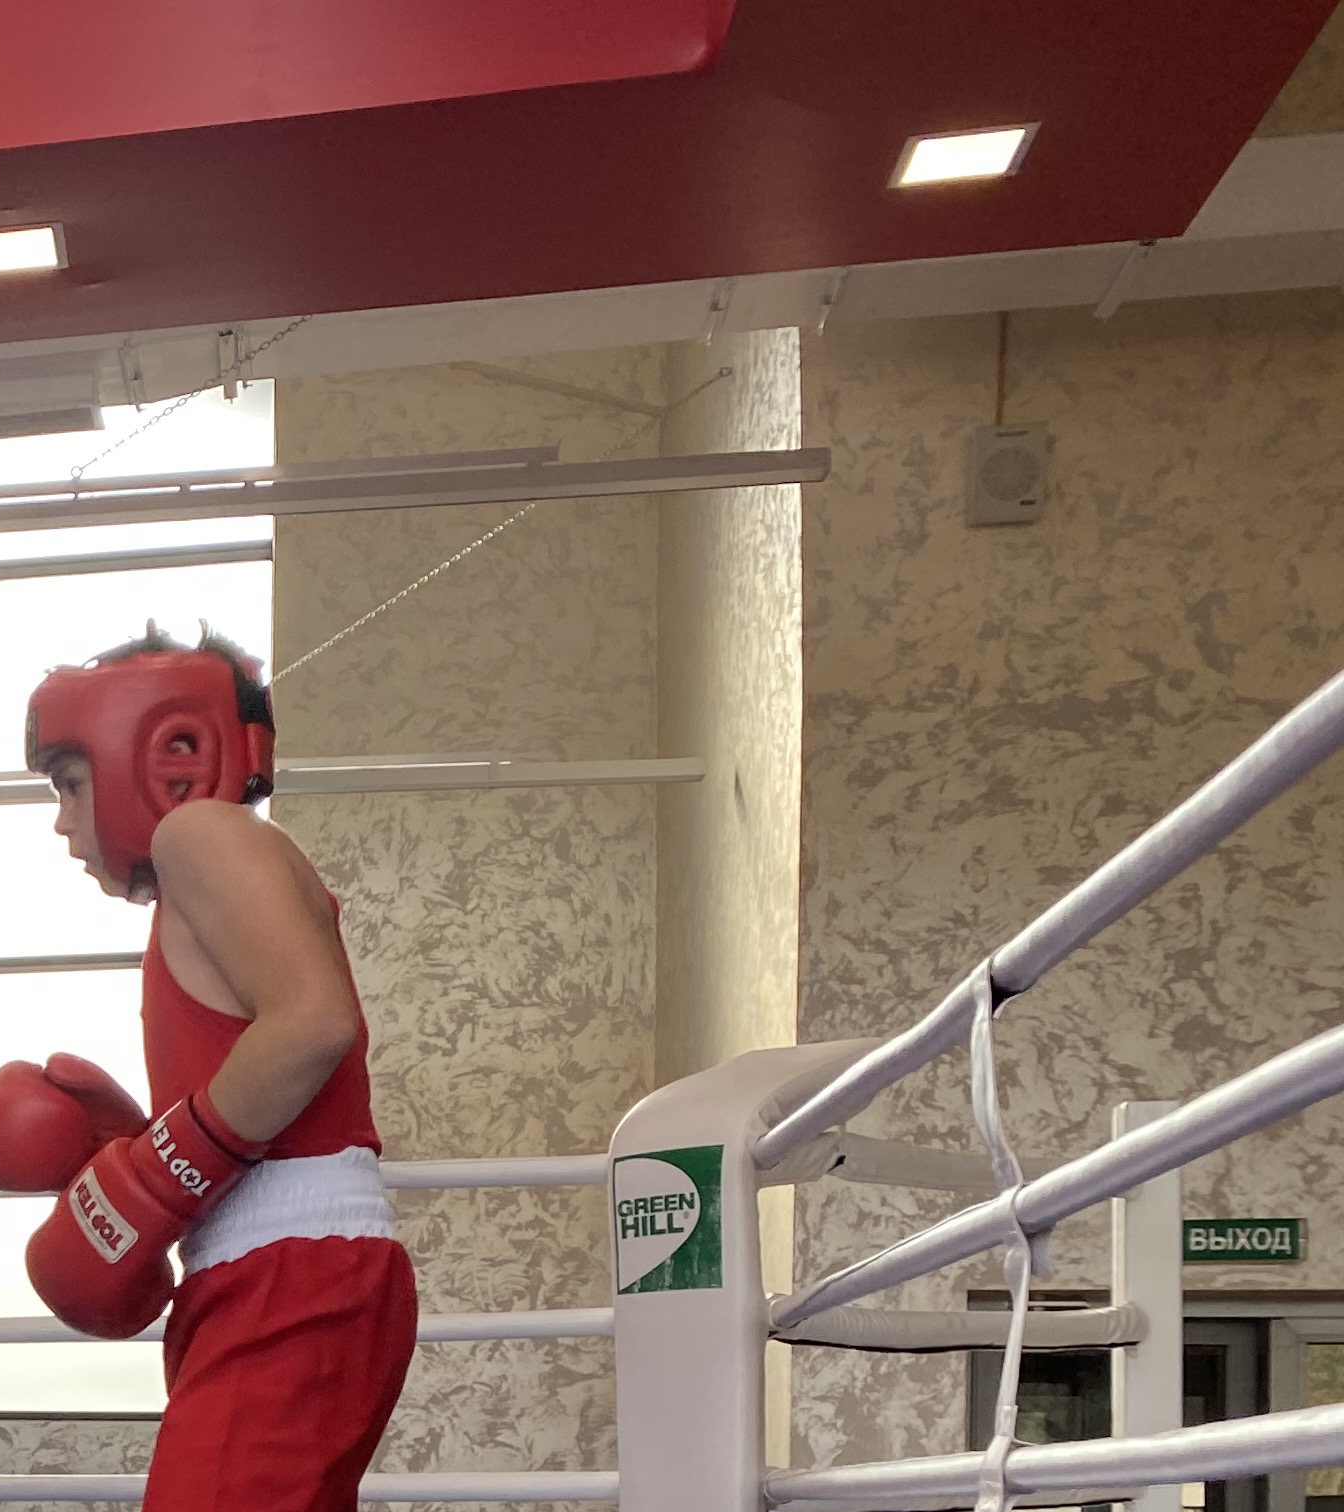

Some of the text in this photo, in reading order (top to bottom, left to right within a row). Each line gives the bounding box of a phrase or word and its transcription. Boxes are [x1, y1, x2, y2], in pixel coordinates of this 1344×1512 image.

[169, 1157, 212, 1197] TOP
[618, 1192, 695, 1217] GREEN
[91, 1214, 124, 1251] TOP
[621, 1213, 685, 1239] HILL
[1189, 1227, 1292, 1255] ВЫХОД
